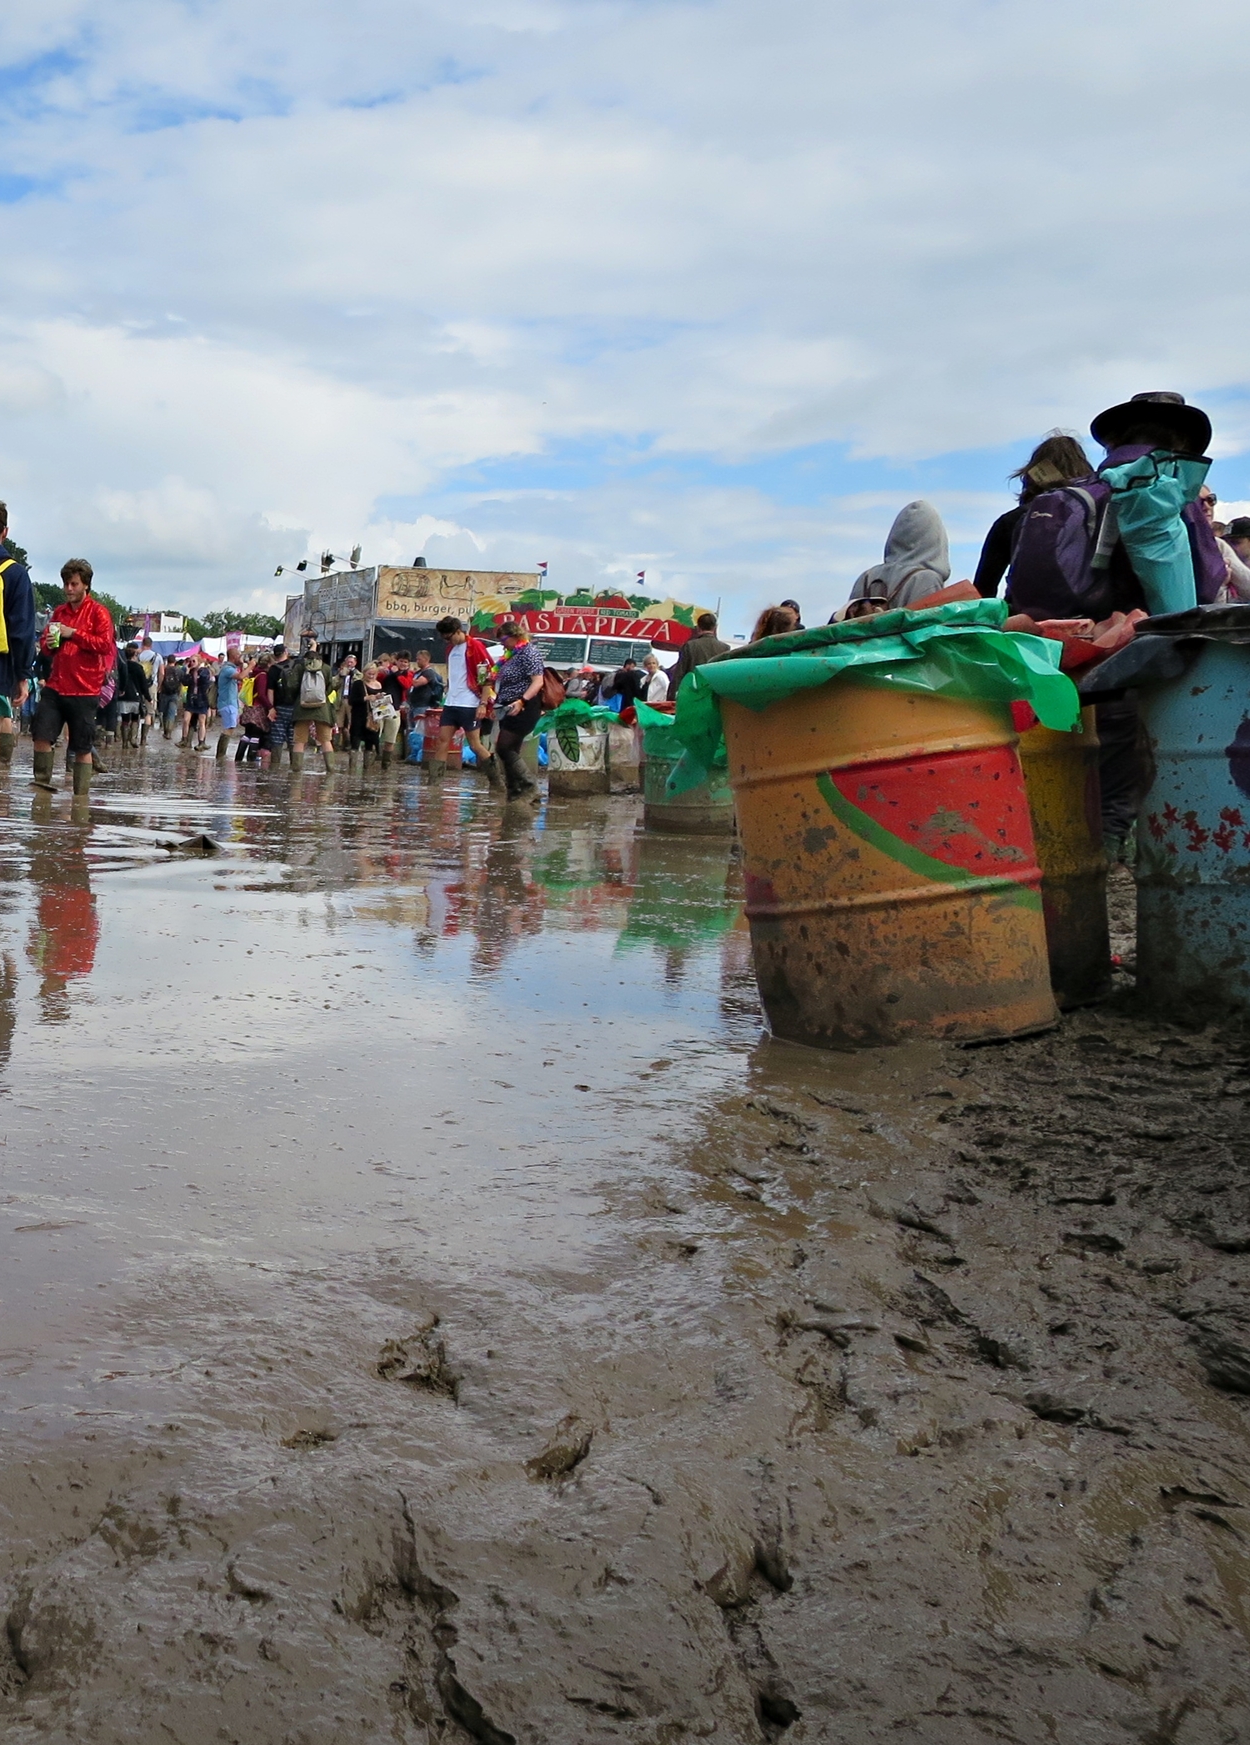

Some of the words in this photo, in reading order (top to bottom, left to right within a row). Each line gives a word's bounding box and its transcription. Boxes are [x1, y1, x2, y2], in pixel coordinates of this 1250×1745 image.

[386, 600, 410, 613] bbq,
[414, 602, 454, 616] burger,
[613, 610, 637, 618] TOMATO
[502, 613, 587, 632] PASTA
[594, 617, 671, 641] PIZZA
